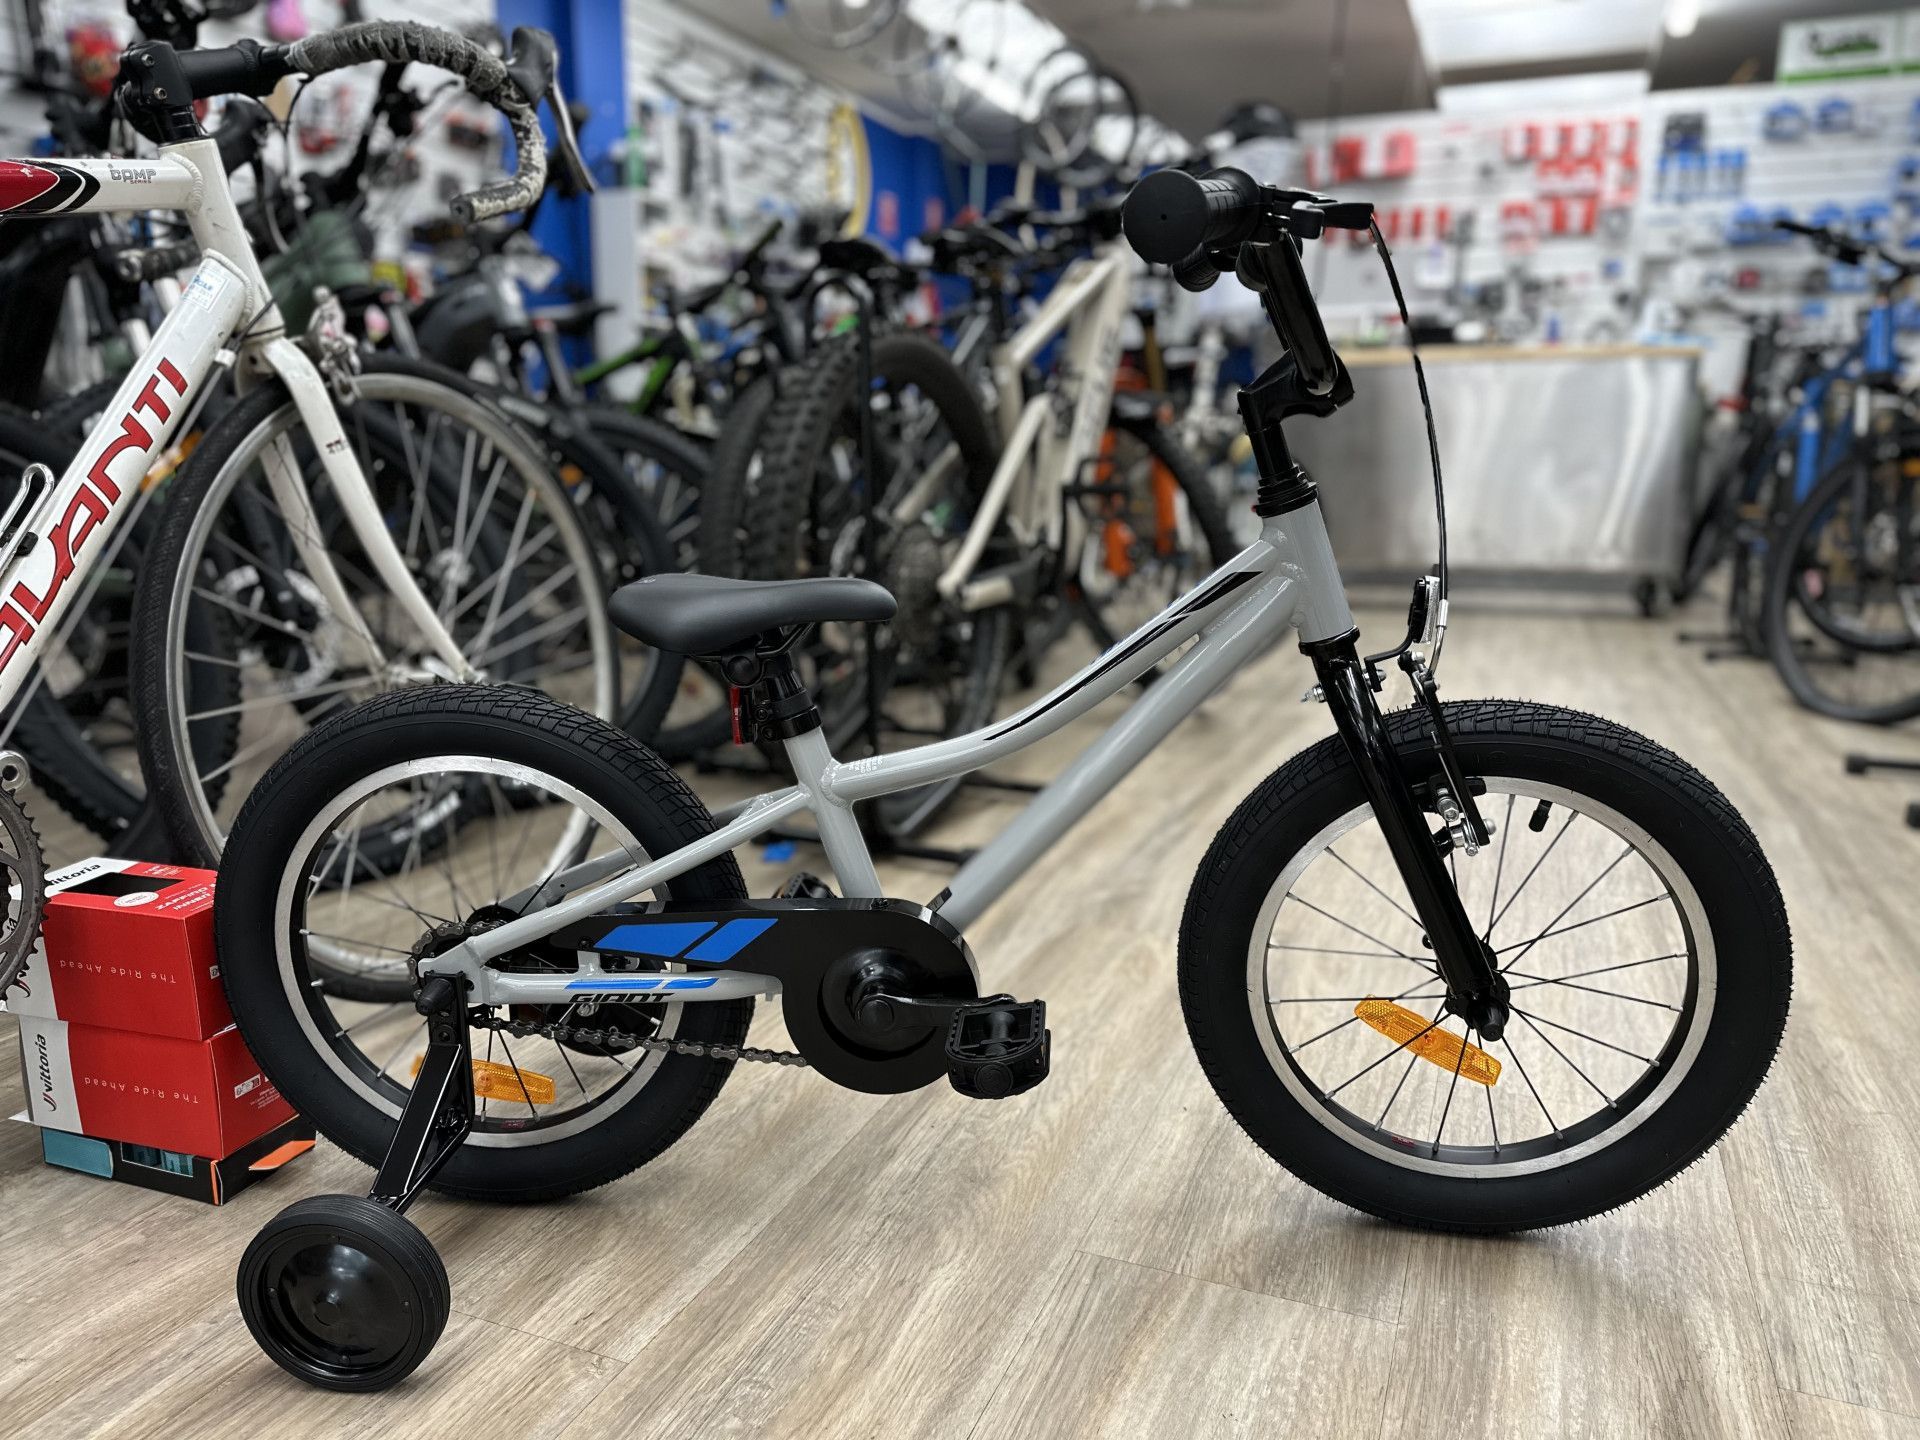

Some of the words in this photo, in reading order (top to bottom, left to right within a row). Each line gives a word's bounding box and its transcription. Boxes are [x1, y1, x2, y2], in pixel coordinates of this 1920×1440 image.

[60, 959, 102, 973] Ahead
[111, 966, 142, 979] Ride
[151, 972, 177, 984] The
[568, 992, 675, 1003] GIANT
[35, 1033, 53, 1093] vittoria
[84, 1077, 126, 1092] Ahead
[134, 1085, 165, 1099] Ride
[174, 1092, 199, 1104] The
